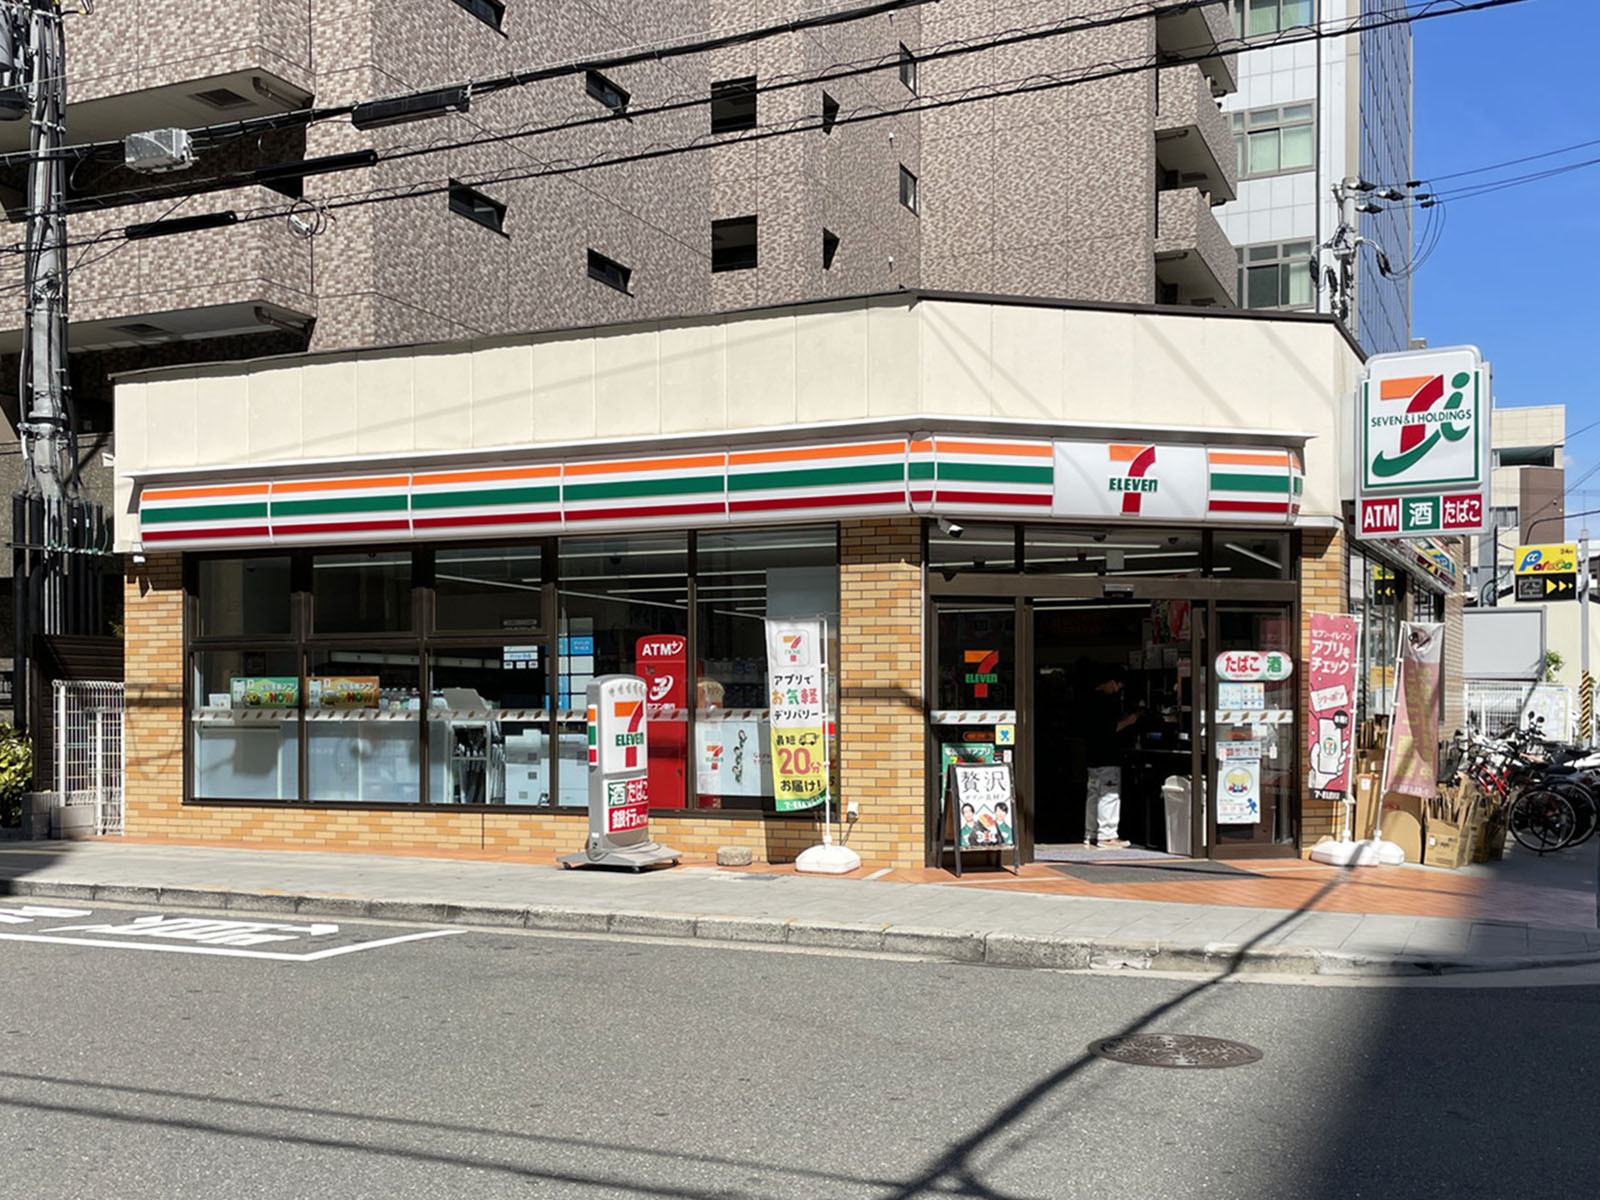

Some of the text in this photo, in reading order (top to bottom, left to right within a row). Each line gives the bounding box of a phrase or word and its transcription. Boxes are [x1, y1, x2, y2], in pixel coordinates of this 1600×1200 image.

[1417, 409, 1472, 423] HOLDINGS
[1109, 445, 1156, 513] 7
[1364, 504, 1397, 528] ATM
[1409, 502, 1434, 527] 酒
[1444, 499, 1480, 523] たばこ
[642, 643, 671, 656] ATM
[1312, 639, 1350, 658] アプリを
[965, 650, 998, 697] 7
[1225, 656, 1282, 672] たばこ 酒
[1312, 657, 1349, 675] チェック
[774, 674, 814, 686] アプリで
[772, 688, 818, 705] お気軽
[774, 710, 818, 720] デリバリー
[614, 700, 644, 768] 7
[777, 748, 822, 775] 20分
[961, 770, 1007, 793] 贅沢
[609, 783, 626, 805] 酒
